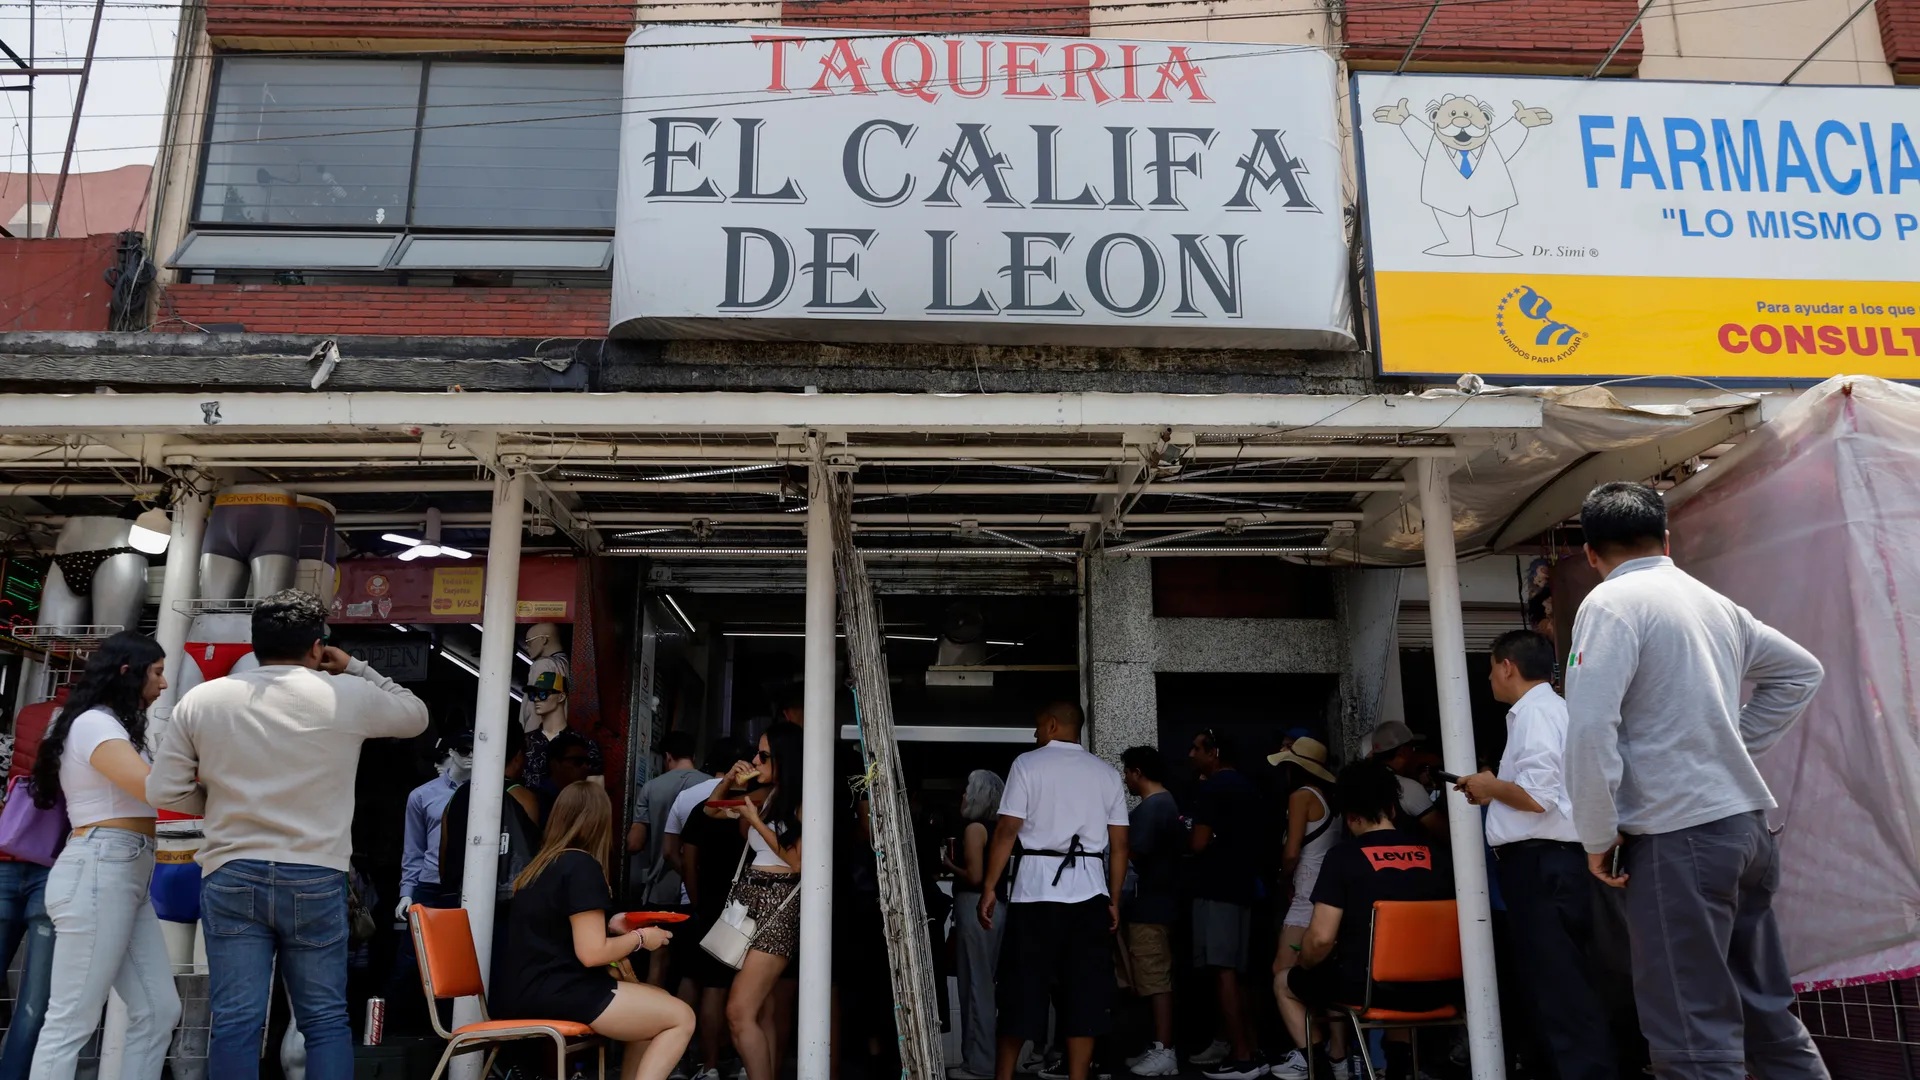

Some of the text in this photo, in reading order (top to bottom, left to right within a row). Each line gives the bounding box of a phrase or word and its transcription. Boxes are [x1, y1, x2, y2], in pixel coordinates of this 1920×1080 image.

[750, 35, 1217, 104] TAQUERIA
[643, 117, 1324, 214] EL CALIFA
[1578, 114, 1920, 196] FARMACIA
[1662, 208, 1734, 238] "LO
[1746, 210, 1882, 241] MISMO
[1532, 245, 1553, 257] Dr.
[1556, 245, 1585, 258] Simi
[716, 226, 1248, 320] DE LEON
[1756, 301, 1790, 313] Para
[1794, 303, 1844, 316] ayudar
[1849, 305, 1858, 315] a
[1861, 303, 1884, 315] los
[1887, 305, 1916, 318] que
[1503, 335, 1582, 363] UNIDOS PARA AYUDAR
[457, 599, 480, 608] VISA
